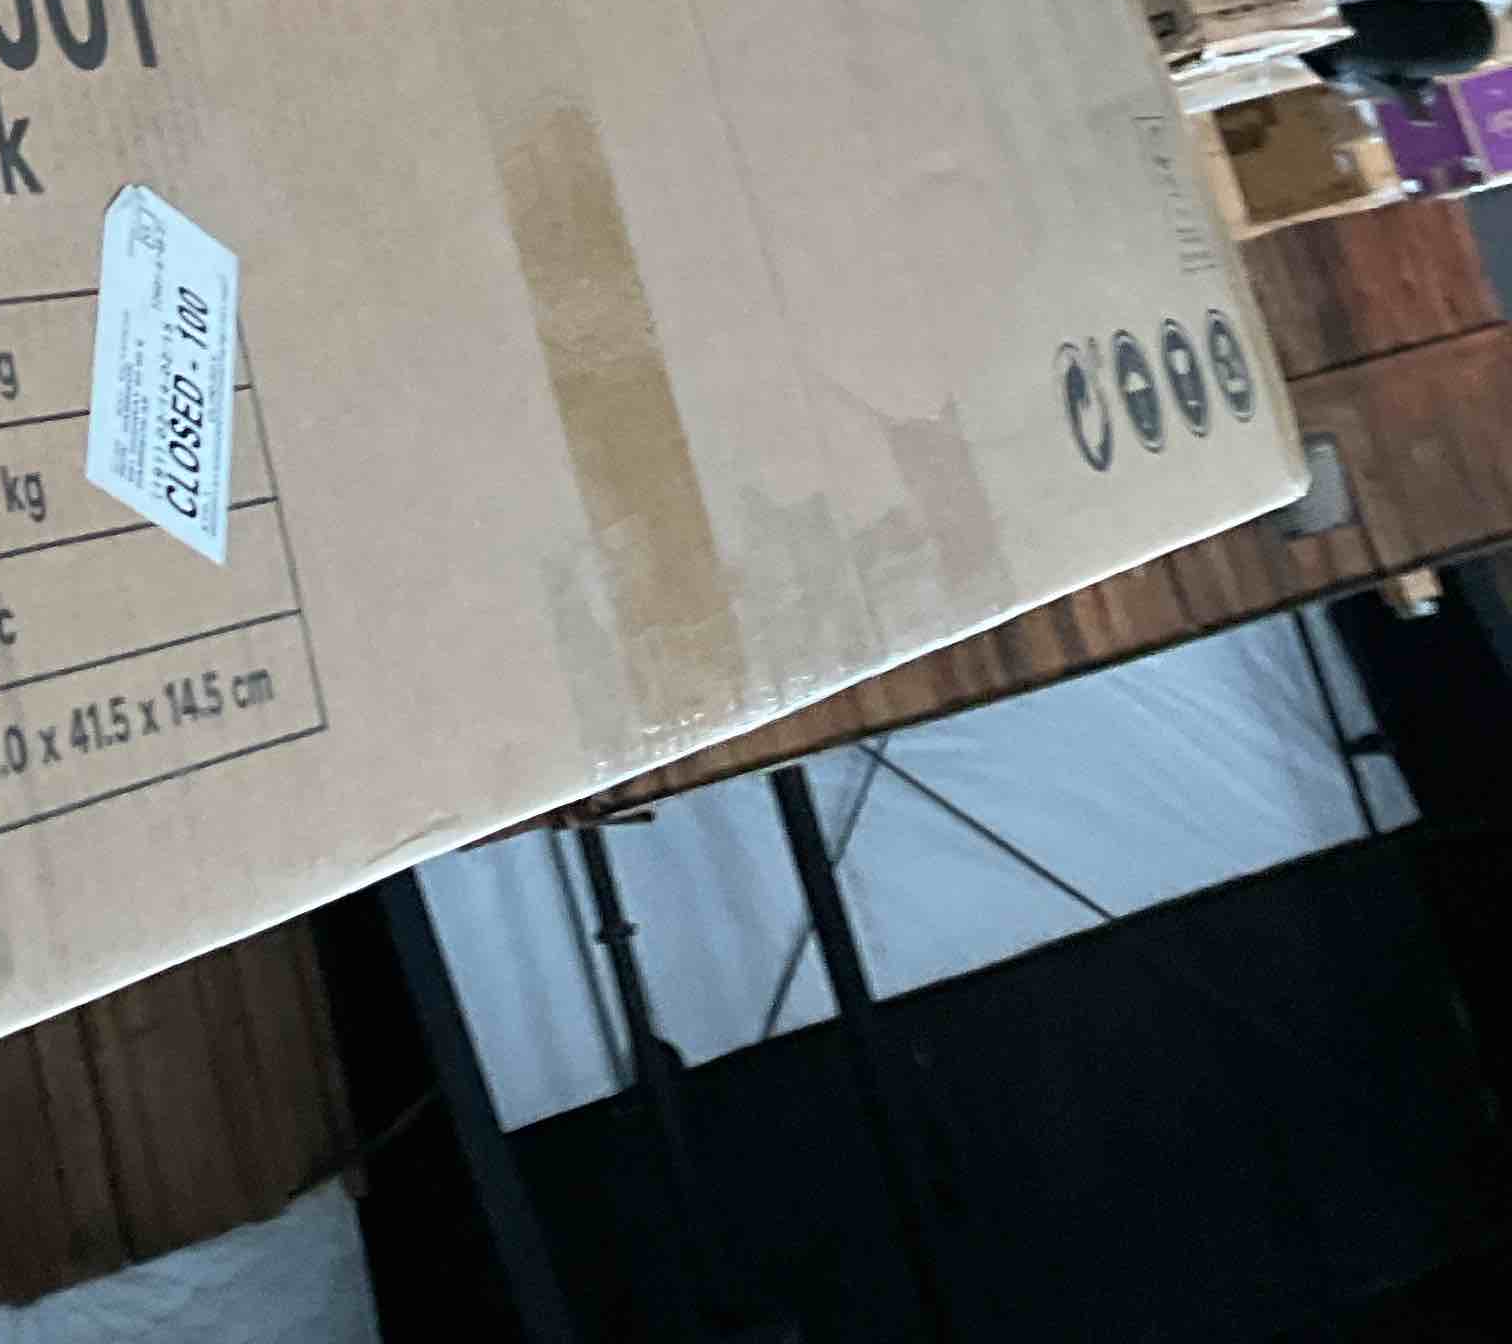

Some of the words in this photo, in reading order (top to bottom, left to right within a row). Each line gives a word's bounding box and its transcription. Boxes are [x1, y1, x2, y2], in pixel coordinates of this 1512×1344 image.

[176, 285, 210, 350] 100
[166, 374, 205, 520] CLOSED
[0, 465, 47, 522] kg
[40, 725, 63, 764] x
[69, 693, 132, 755] 41.5
[139, 700, 161, 737] x
[162, 670, 224, 727] 14.5
[229, 666, 275, 713] cm
